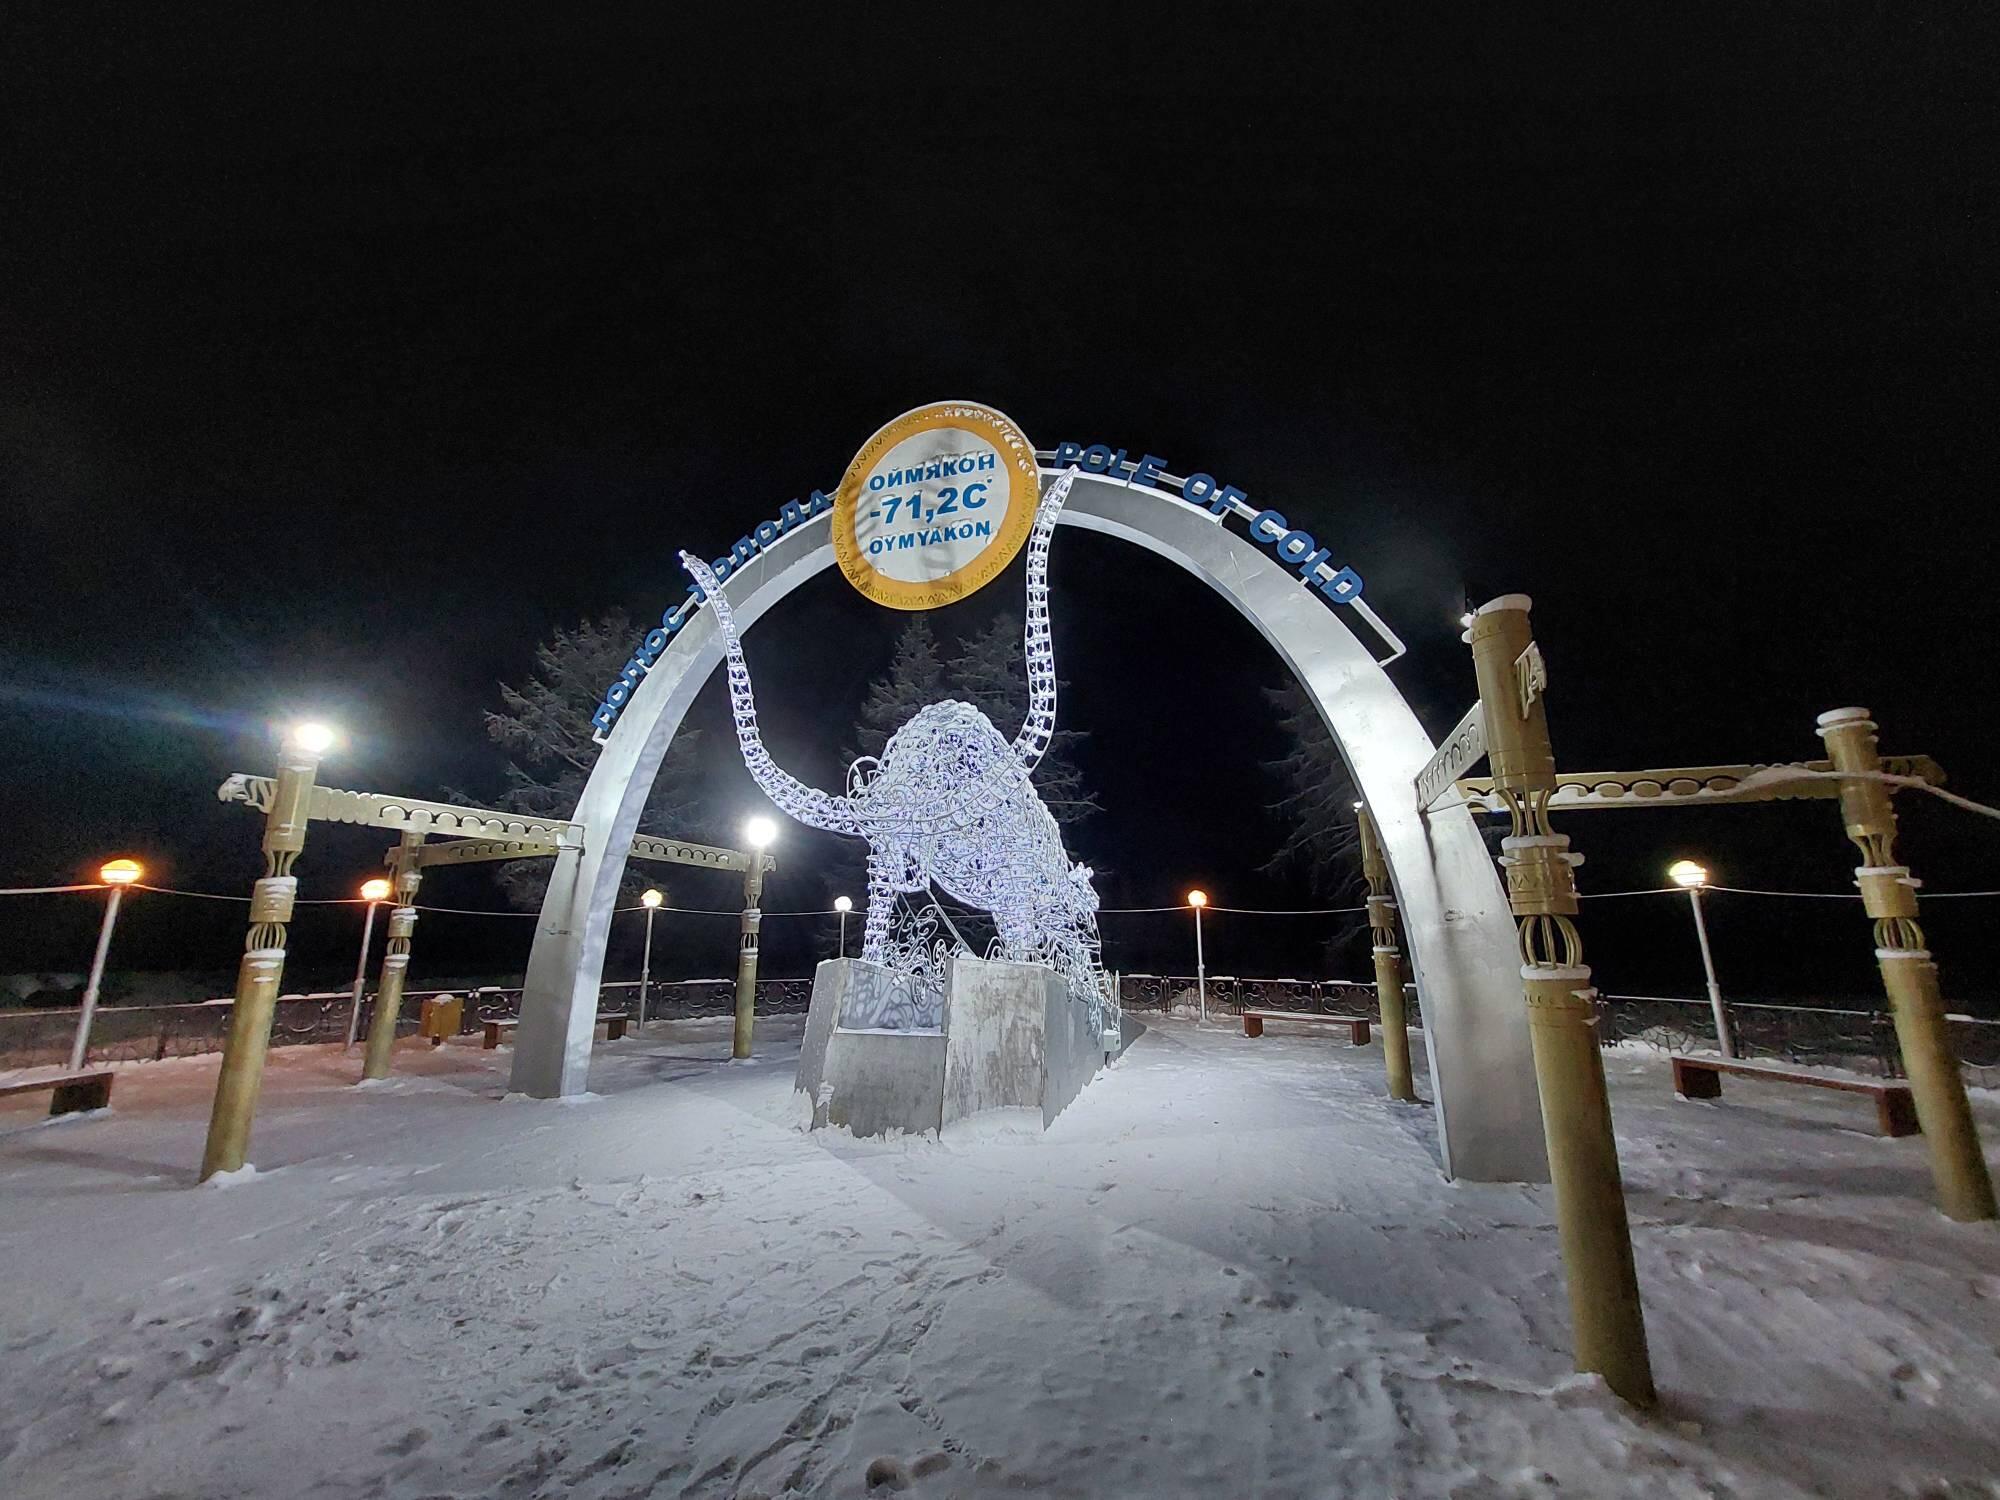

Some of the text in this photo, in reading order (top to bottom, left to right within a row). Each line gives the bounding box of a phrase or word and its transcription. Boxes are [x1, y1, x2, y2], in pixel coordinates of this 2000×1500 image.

[869, 453, 995, 491] ОЙМЯКОН
[869, 520, 991, 555] OYMYAKON
[1053, 441, 1363, 603] POLE OF COLD
[591, 605, 685, 732] ПОЛЮС
